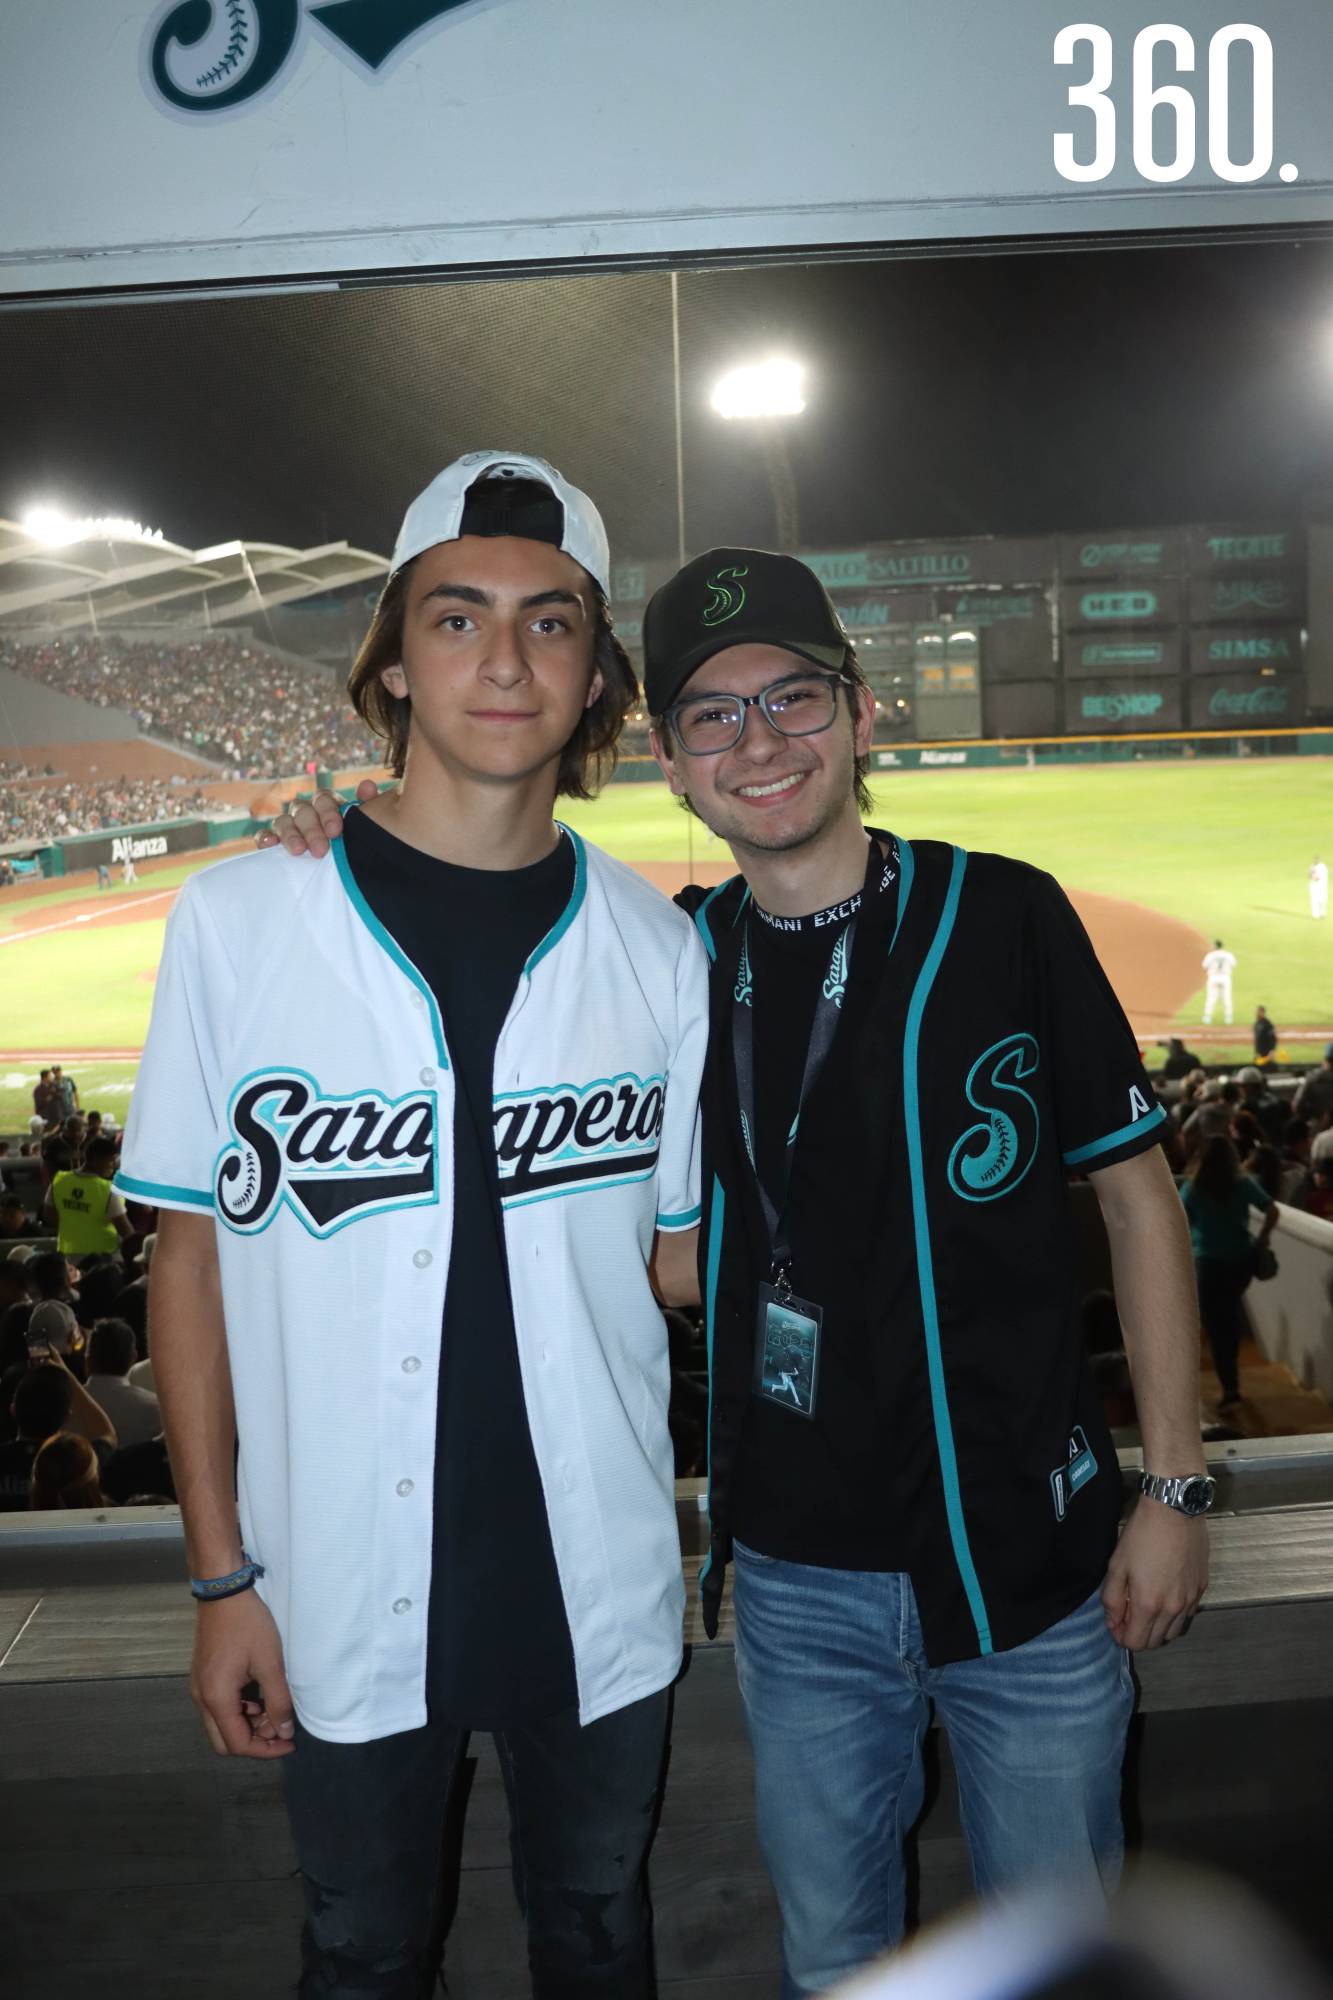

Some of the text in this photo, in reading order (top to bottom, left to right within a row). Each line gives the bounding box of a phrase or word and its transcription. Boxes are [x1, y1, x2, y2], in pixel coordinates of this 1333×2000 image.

[1208, 534, 1288, 561] TECATE
[873, 554, 970, 577] SALTILLO
[1208, 638, 1289, 660] SIMSA
[112, 836, 168, 863] Alianza
